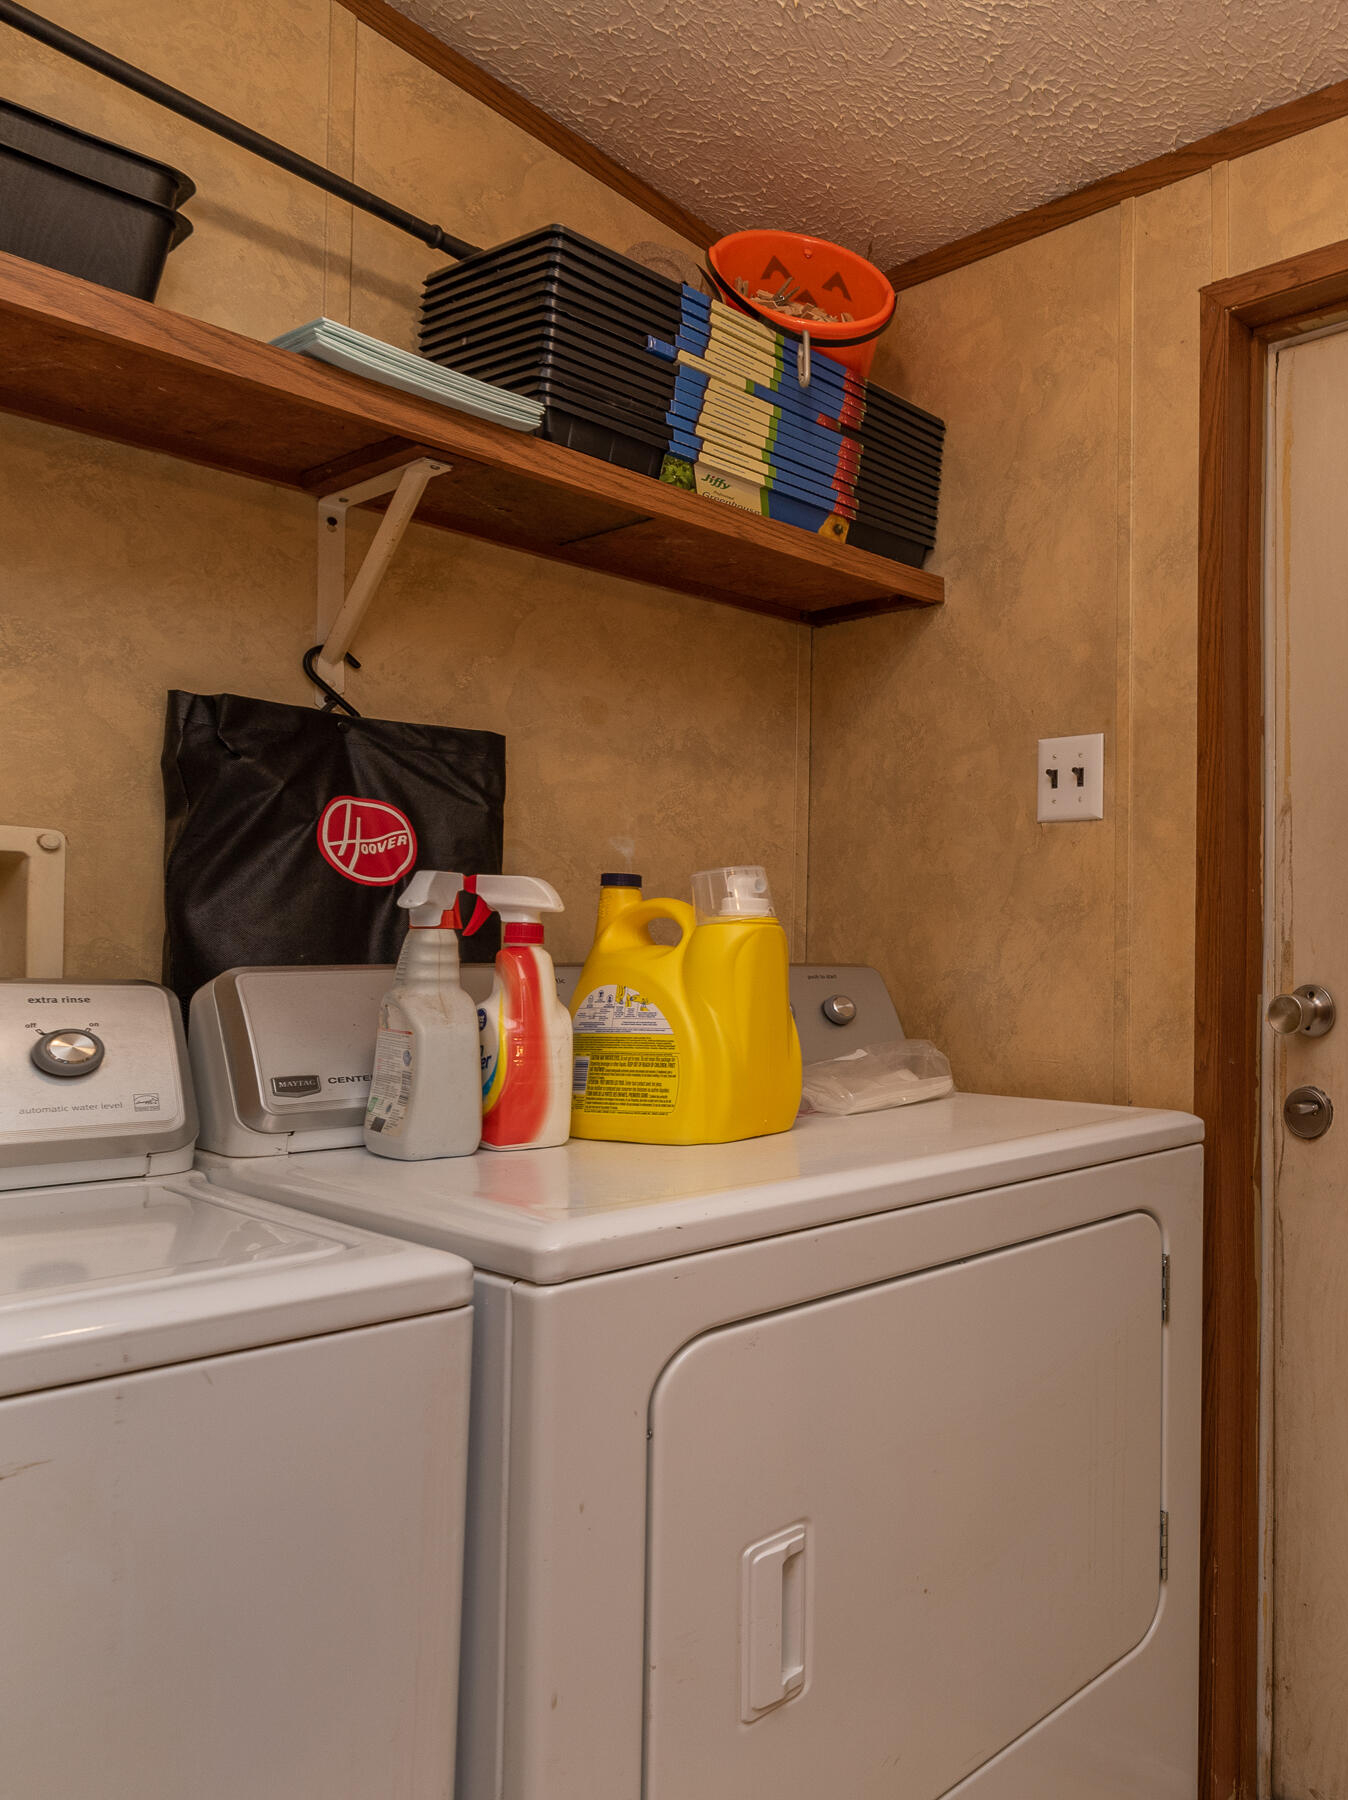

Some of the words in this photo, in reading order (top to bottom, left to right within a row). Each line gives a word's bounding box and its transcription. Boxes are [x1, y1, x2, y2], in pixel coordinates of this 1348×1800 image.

[701, 474, 731, 489] Jiffy
[327, 800, 408, 873] HOOVER
[27, 996, 58, 1004] extra
[61, 996, 91, 1004] rinse
[278, 1080, 317, 1088] MAYTAG
[328, 1074, 373, 1084] CENTE
[18, 1105, 69, 1114] automatic
[100, 1101, 123, 1110] level
